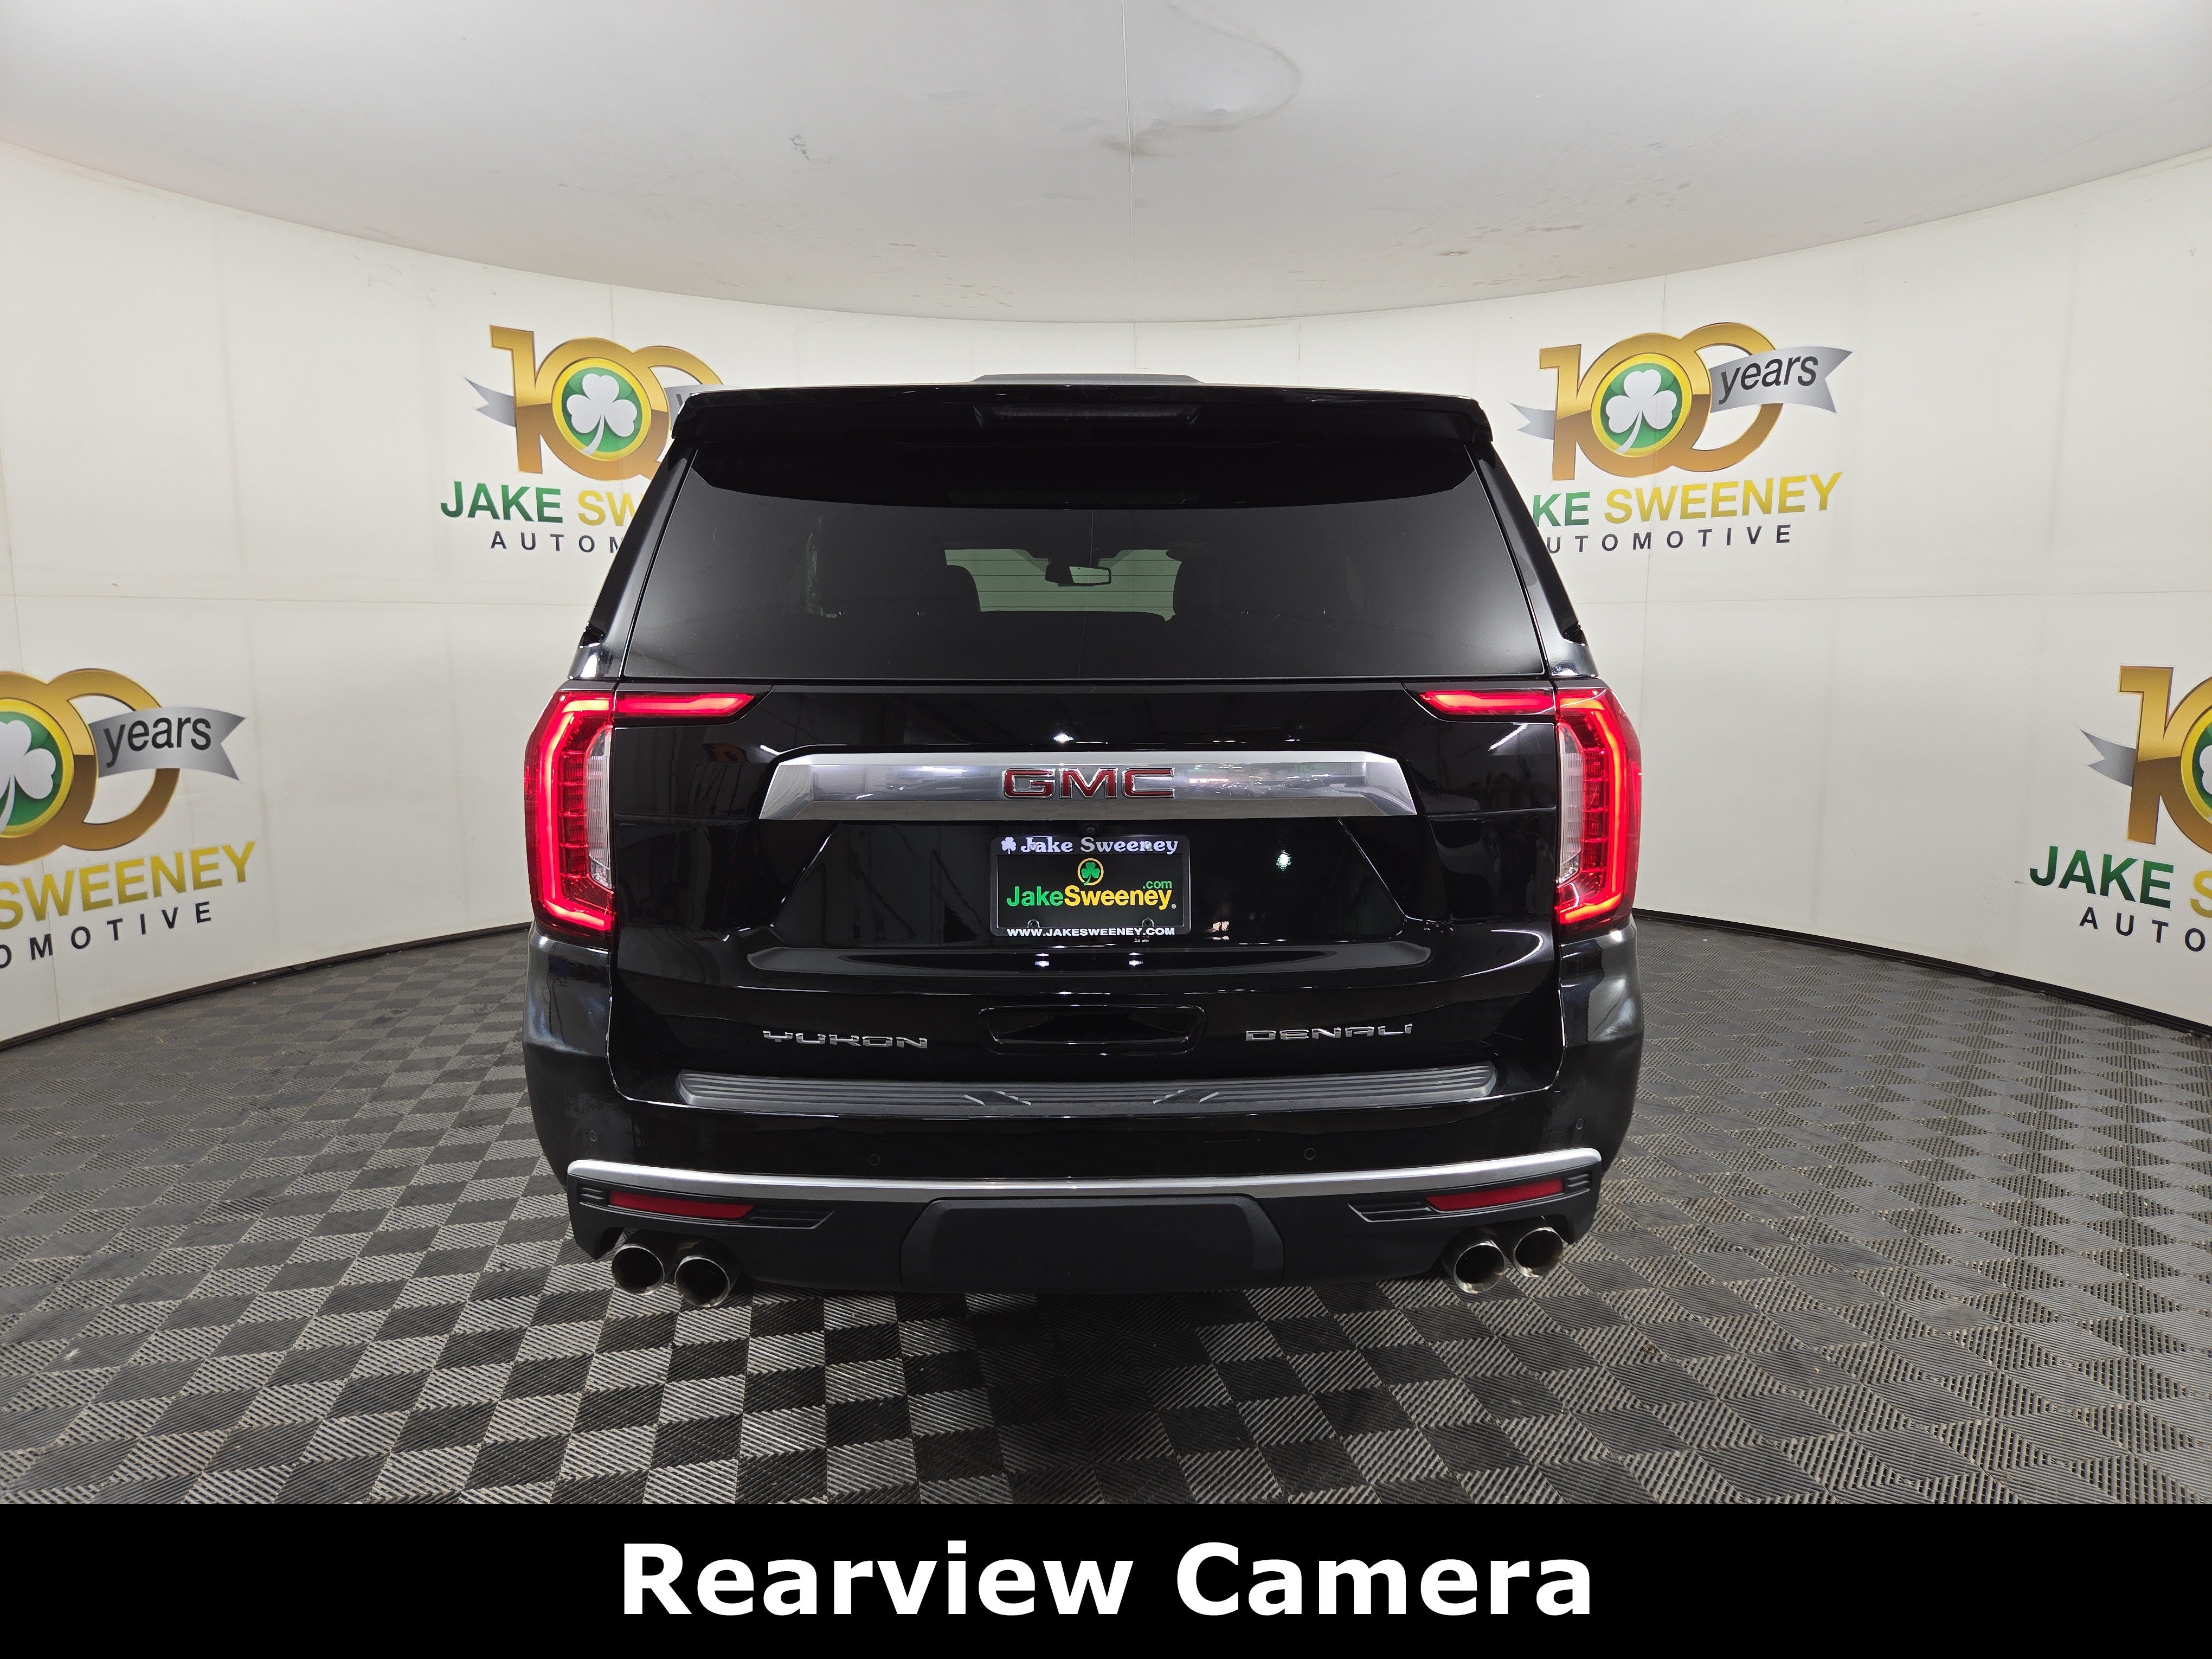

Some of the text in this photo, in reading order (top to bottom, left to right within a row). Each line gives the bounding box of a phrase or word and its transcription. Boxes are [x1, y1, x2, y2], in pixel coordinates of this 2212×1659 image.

[1718, 356, 1818, 405] years
[440, 481, 644, 526] JAKE SW
[1533, 472, 1842, 527] KE SWEENEY
[491, 531, 623, 553] AUTOM
[1547, 525, 1790, 554] UTOMOTIVE
[104, 717, 212, 768] years
[1003, 767, 1175, 799] GMC
[1021, 837, 1178, 855] Jake Sweeney
[2030, 845, 2174, 909] JAKE
[0, 901, 212, 968] OMOTIVE
[1007, 928, 1175, 936] WWW.JAKESWEENEY.COM
[2079, 907, 2206, 951] AUTO
[763, 1031, 928, 1049] YUKON
[1246, 1024, 1413, 1041] DENALI
